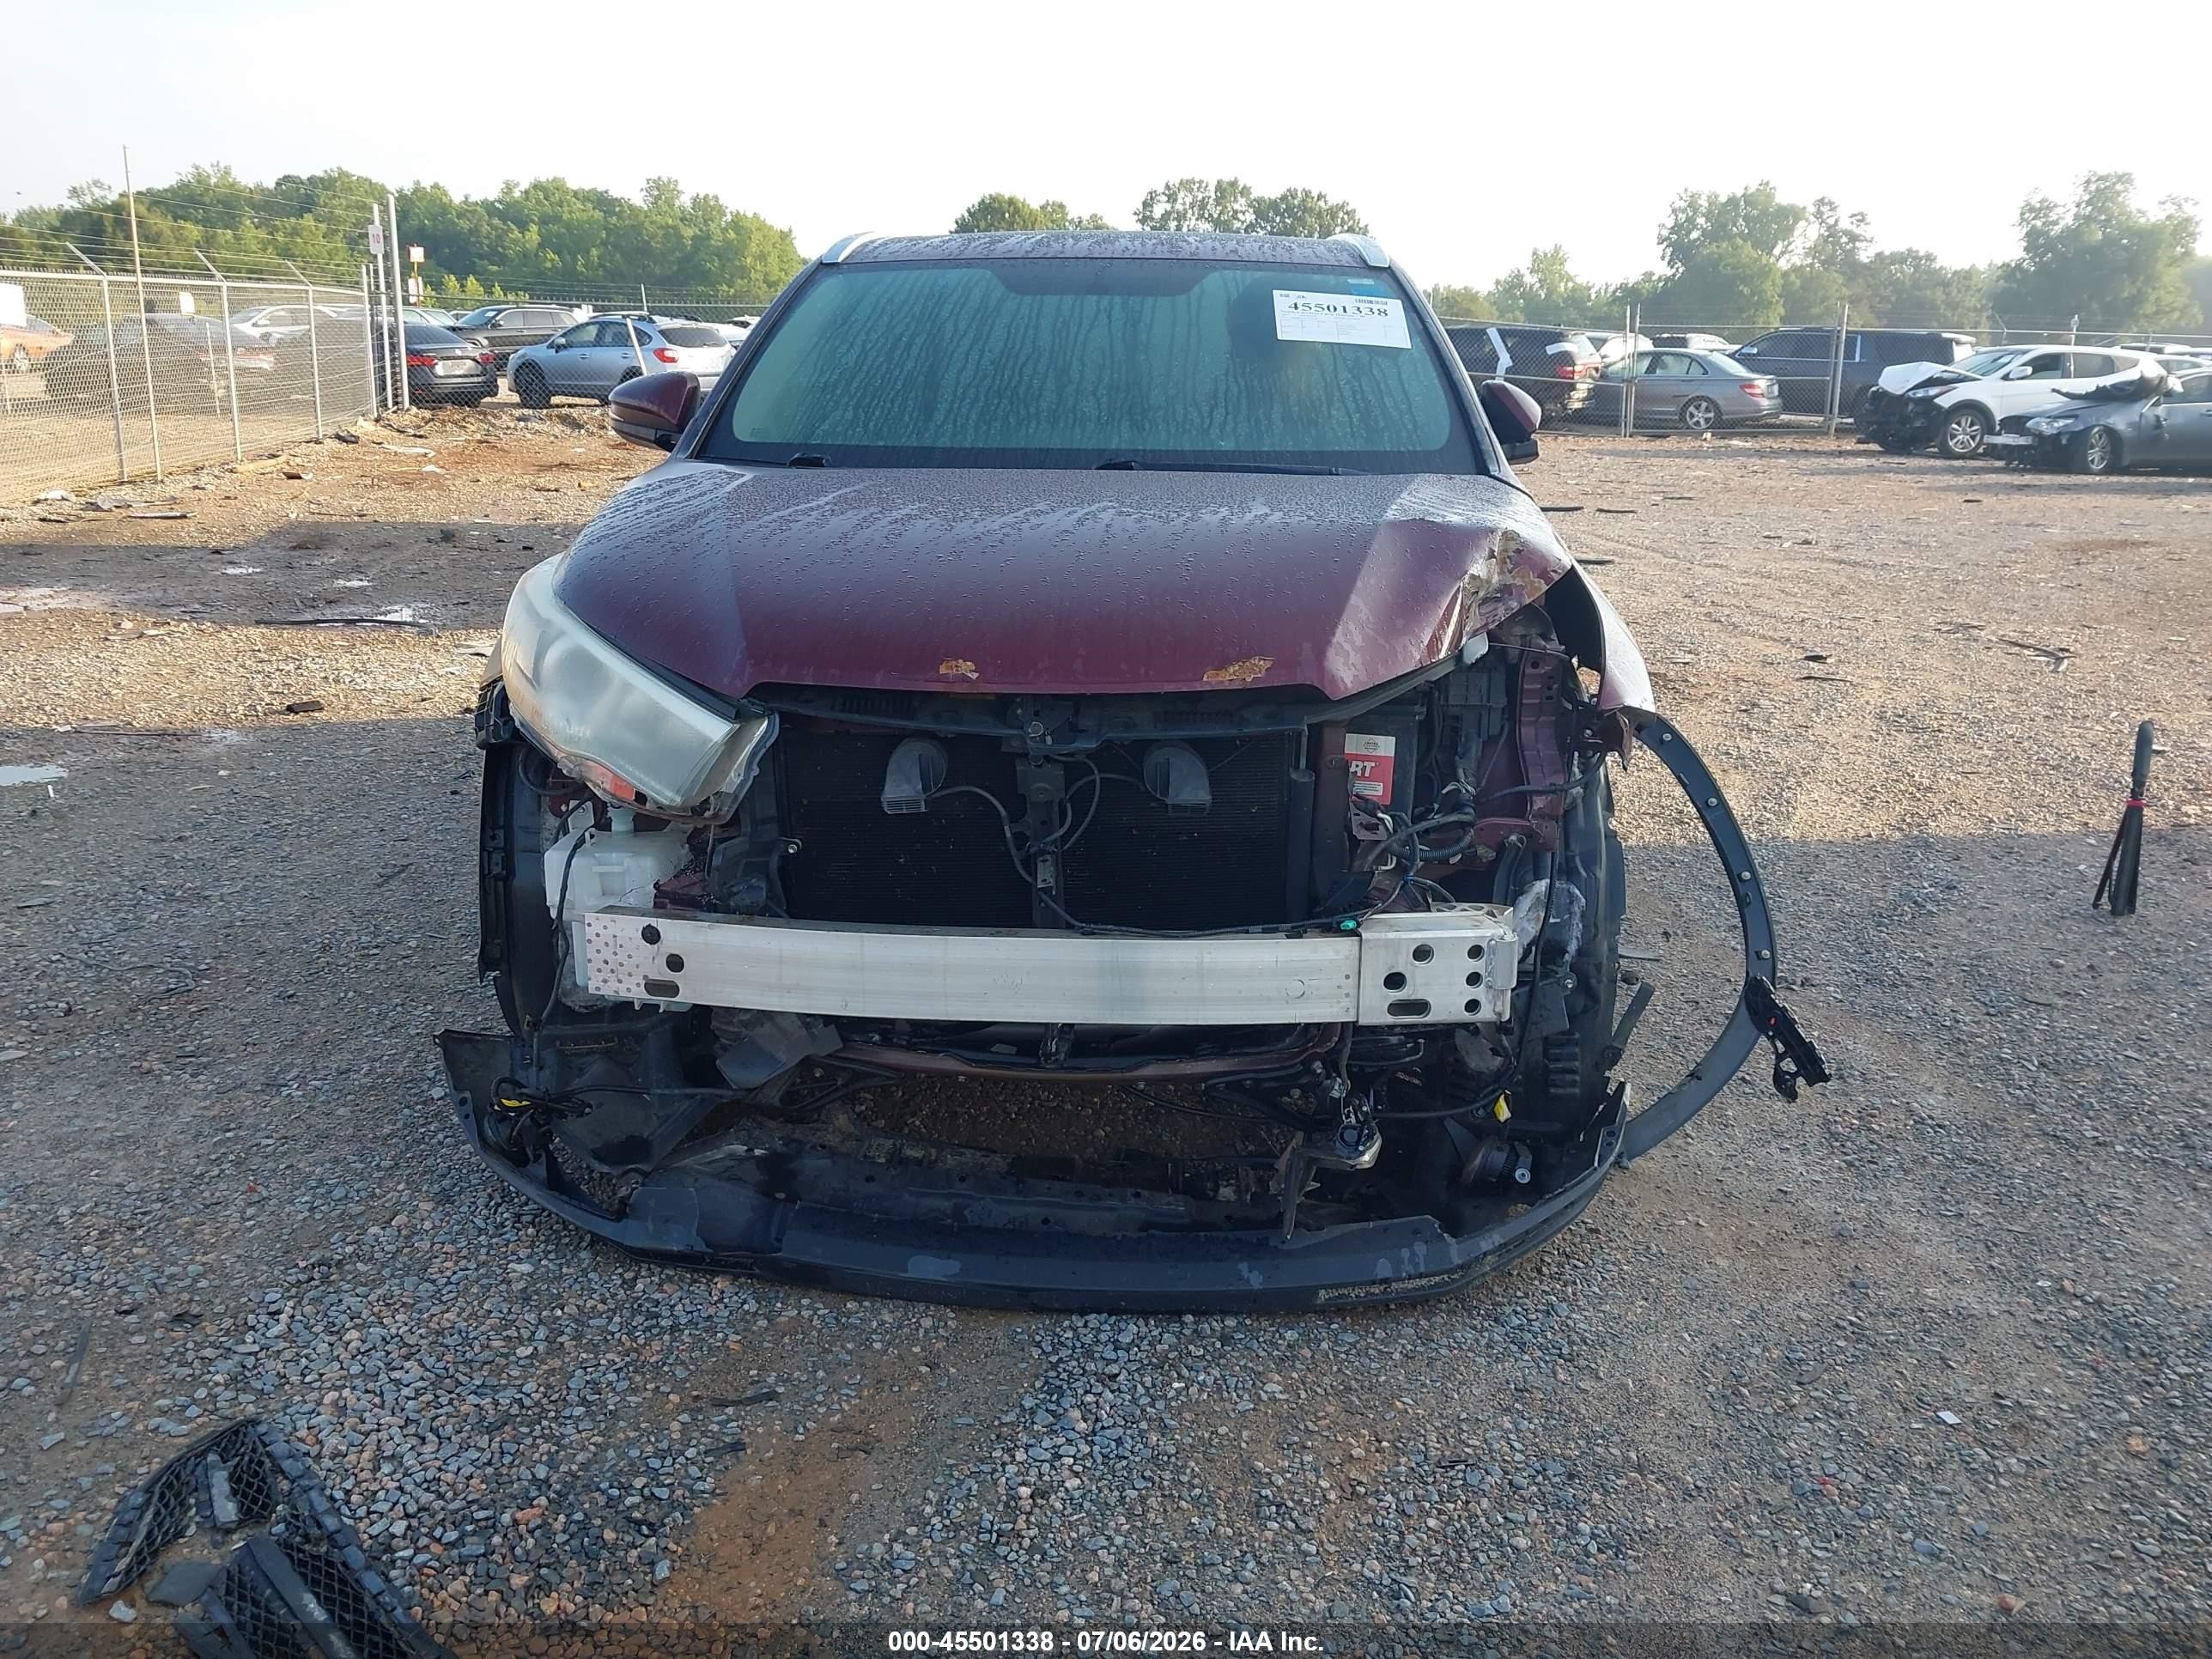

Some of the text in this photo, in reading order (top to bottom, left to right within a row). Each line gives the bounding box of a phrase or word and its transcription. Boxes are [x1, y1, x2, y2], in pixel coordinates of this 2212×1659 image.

[372, 233, 381, 244] 10
[1288, 301, 1389, 318] 45501338
[1348, 760, 1376, 777] RT
